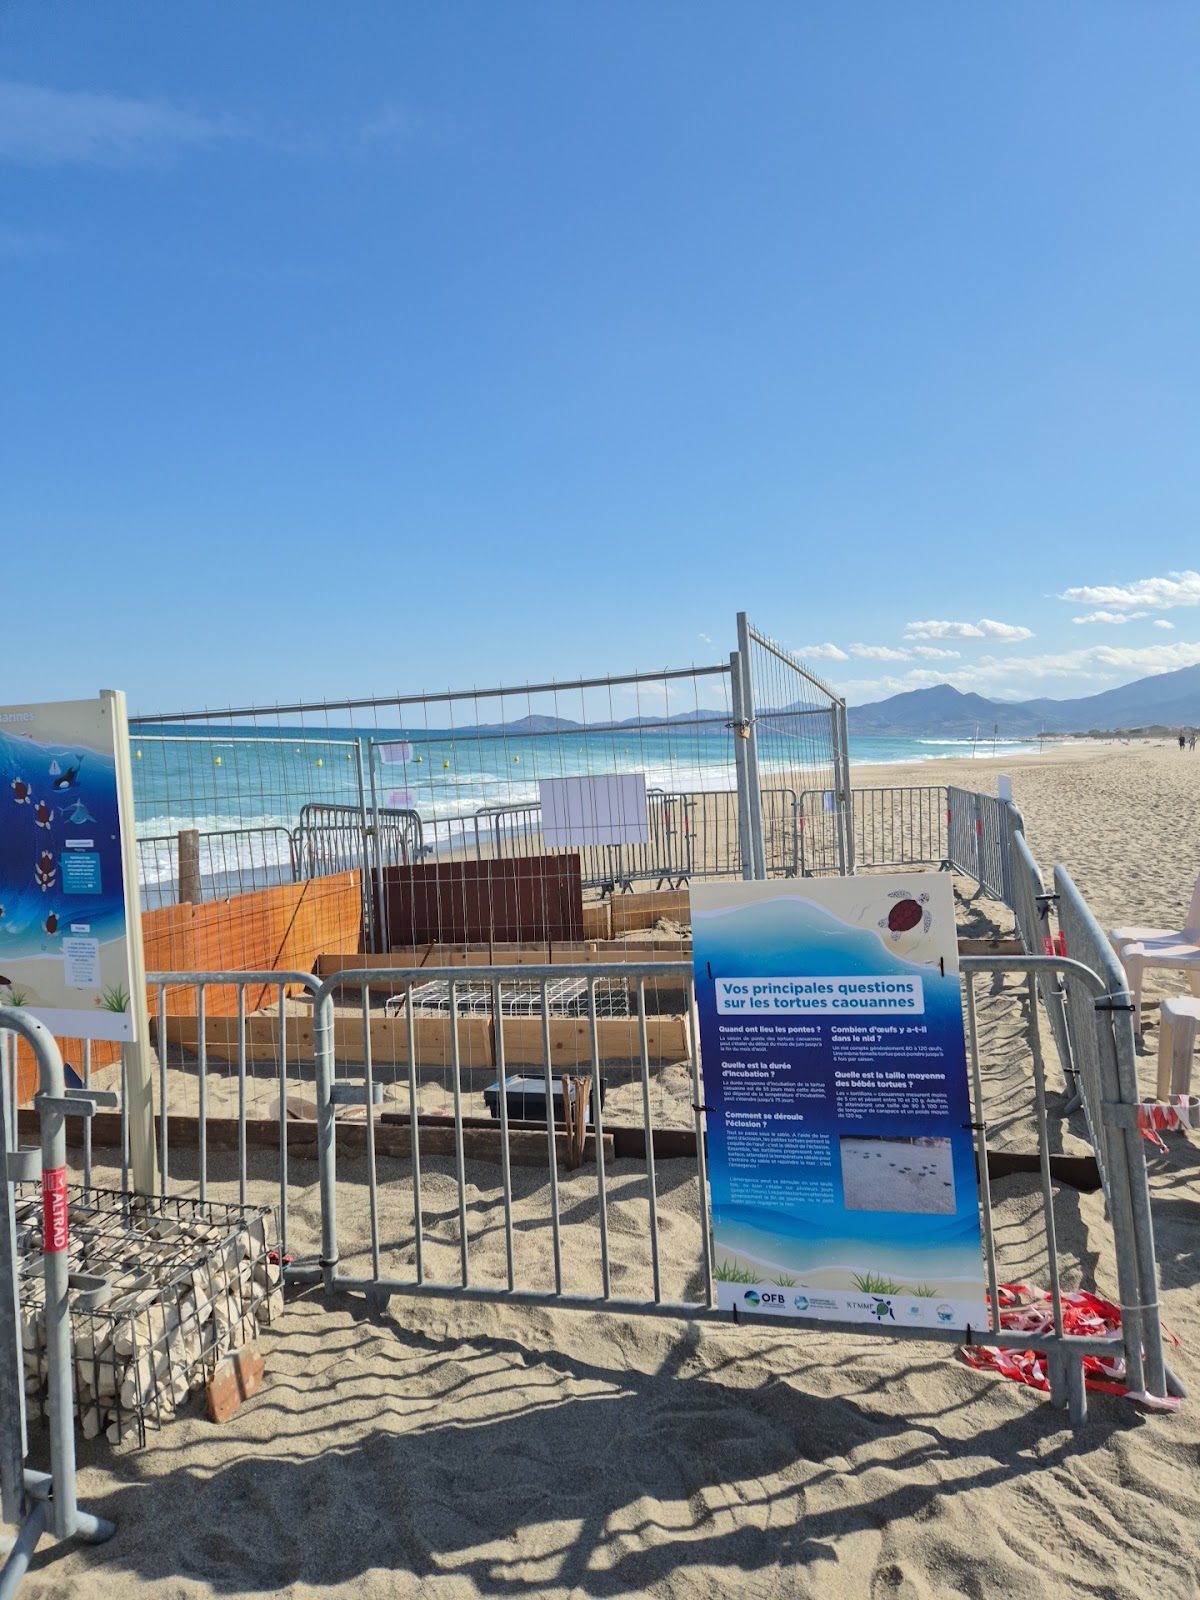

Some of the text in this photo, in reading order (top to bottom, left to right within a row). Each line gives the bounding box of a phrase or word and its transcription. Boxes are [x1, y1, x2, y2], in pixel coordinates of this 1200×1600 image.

[0, 712, 34, 722] arines
[723, 981, 914, 996] Vos principales questions
[724, 998, 915, 1008] sur les tortues caouannes
[788, 1026, 815, 1034] pontes
[726, 1120, 761, 1128] l'éclosion
[52, 1193, 65, 1247] ALTRAD
[761, 1293, 785, 1304] OFB
